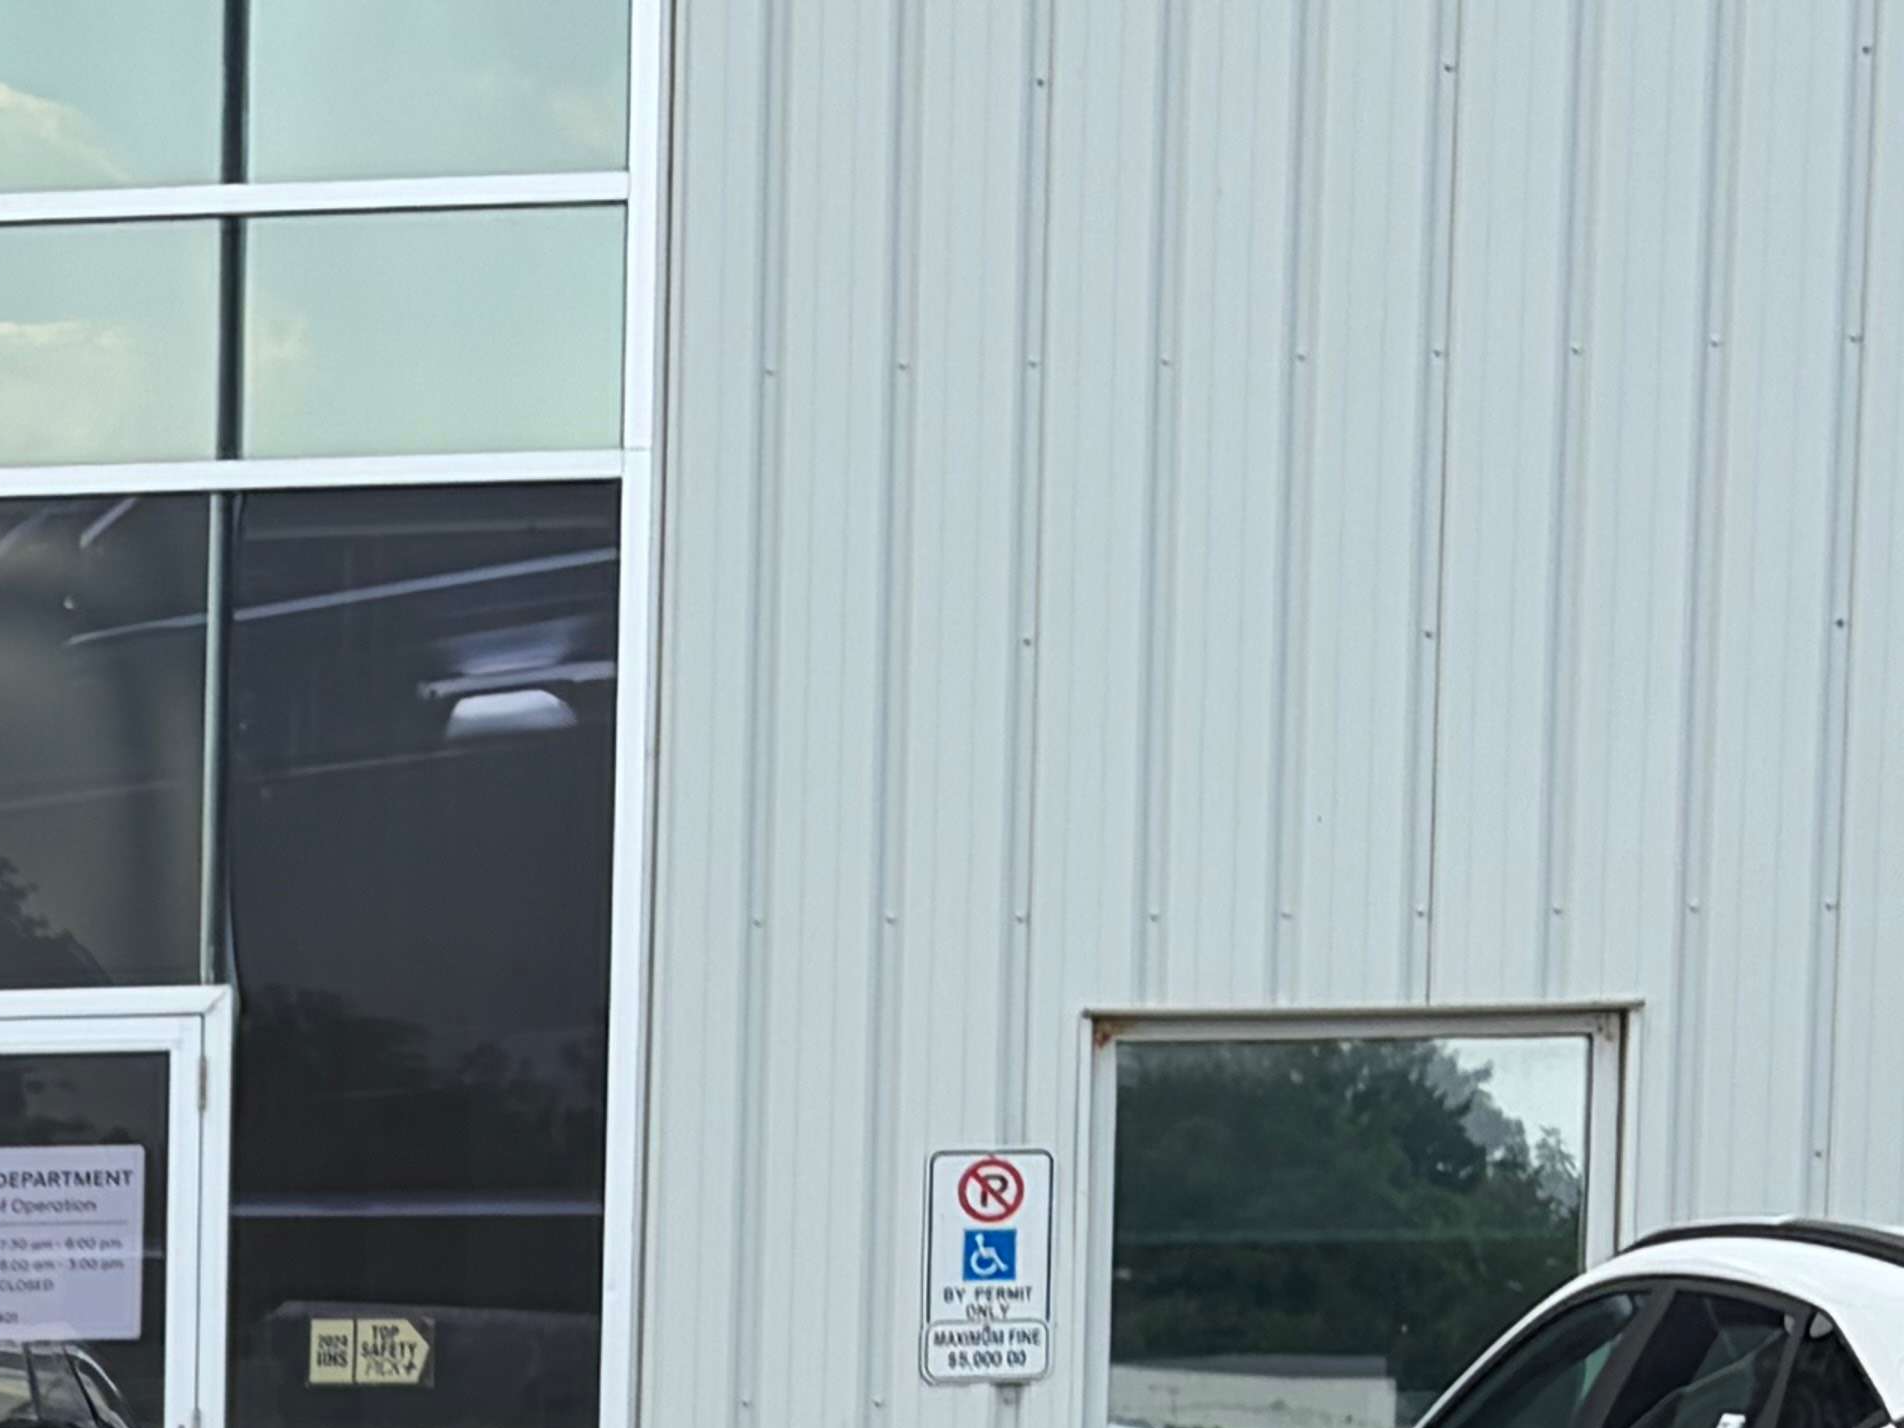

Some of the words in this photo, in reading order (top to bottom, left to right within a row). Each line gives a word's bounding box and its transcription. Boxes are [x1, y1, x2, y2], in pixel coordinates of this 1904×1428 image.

[11, 1198, 98, 1215] Operation
[31, 1240, 53, 1251] am
[99, 1238, 123, 1252] pm
[32, 1260, 55, 1272] am
[99, 1259, 125, 1273] pm
[944, 1285, 966, 1304] BY
[974, 1285, 1033, 1302] PERMIT
[965, 1303, 1010, 1320] ONLY
[933, 1328, 1005, 1347] MAXIMUM
[1009, 1327, 1041, 1346] FINE
[360, 1340, 418, 1359] SAFETY
